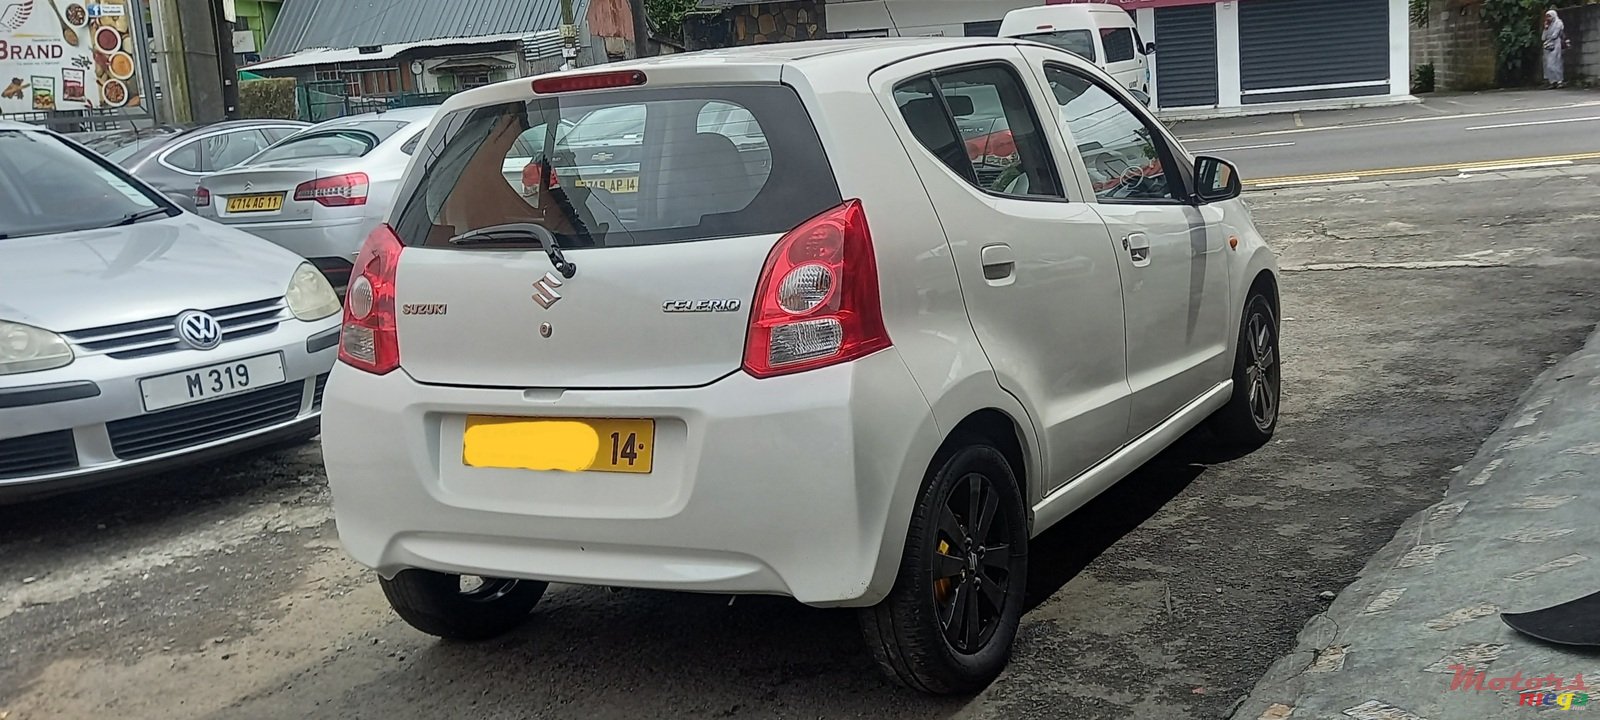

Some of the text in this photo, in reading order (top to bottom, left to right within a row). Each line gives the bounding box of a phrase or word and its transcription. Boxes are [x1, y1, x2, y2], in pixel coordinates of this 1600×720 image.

[0, 40, 63, 60] BRAND
[610, 179, 623, 191] AP
[626, 179, 636, 190] 14
[230, 196, 278, 210] 4714 AG 11
[402, 303, 448, 315] SUZUKI
[662, 299, 741, 313] CELERIO
[185, 363, 250, 398] M 319
[610, 432, 637, 466] 14
